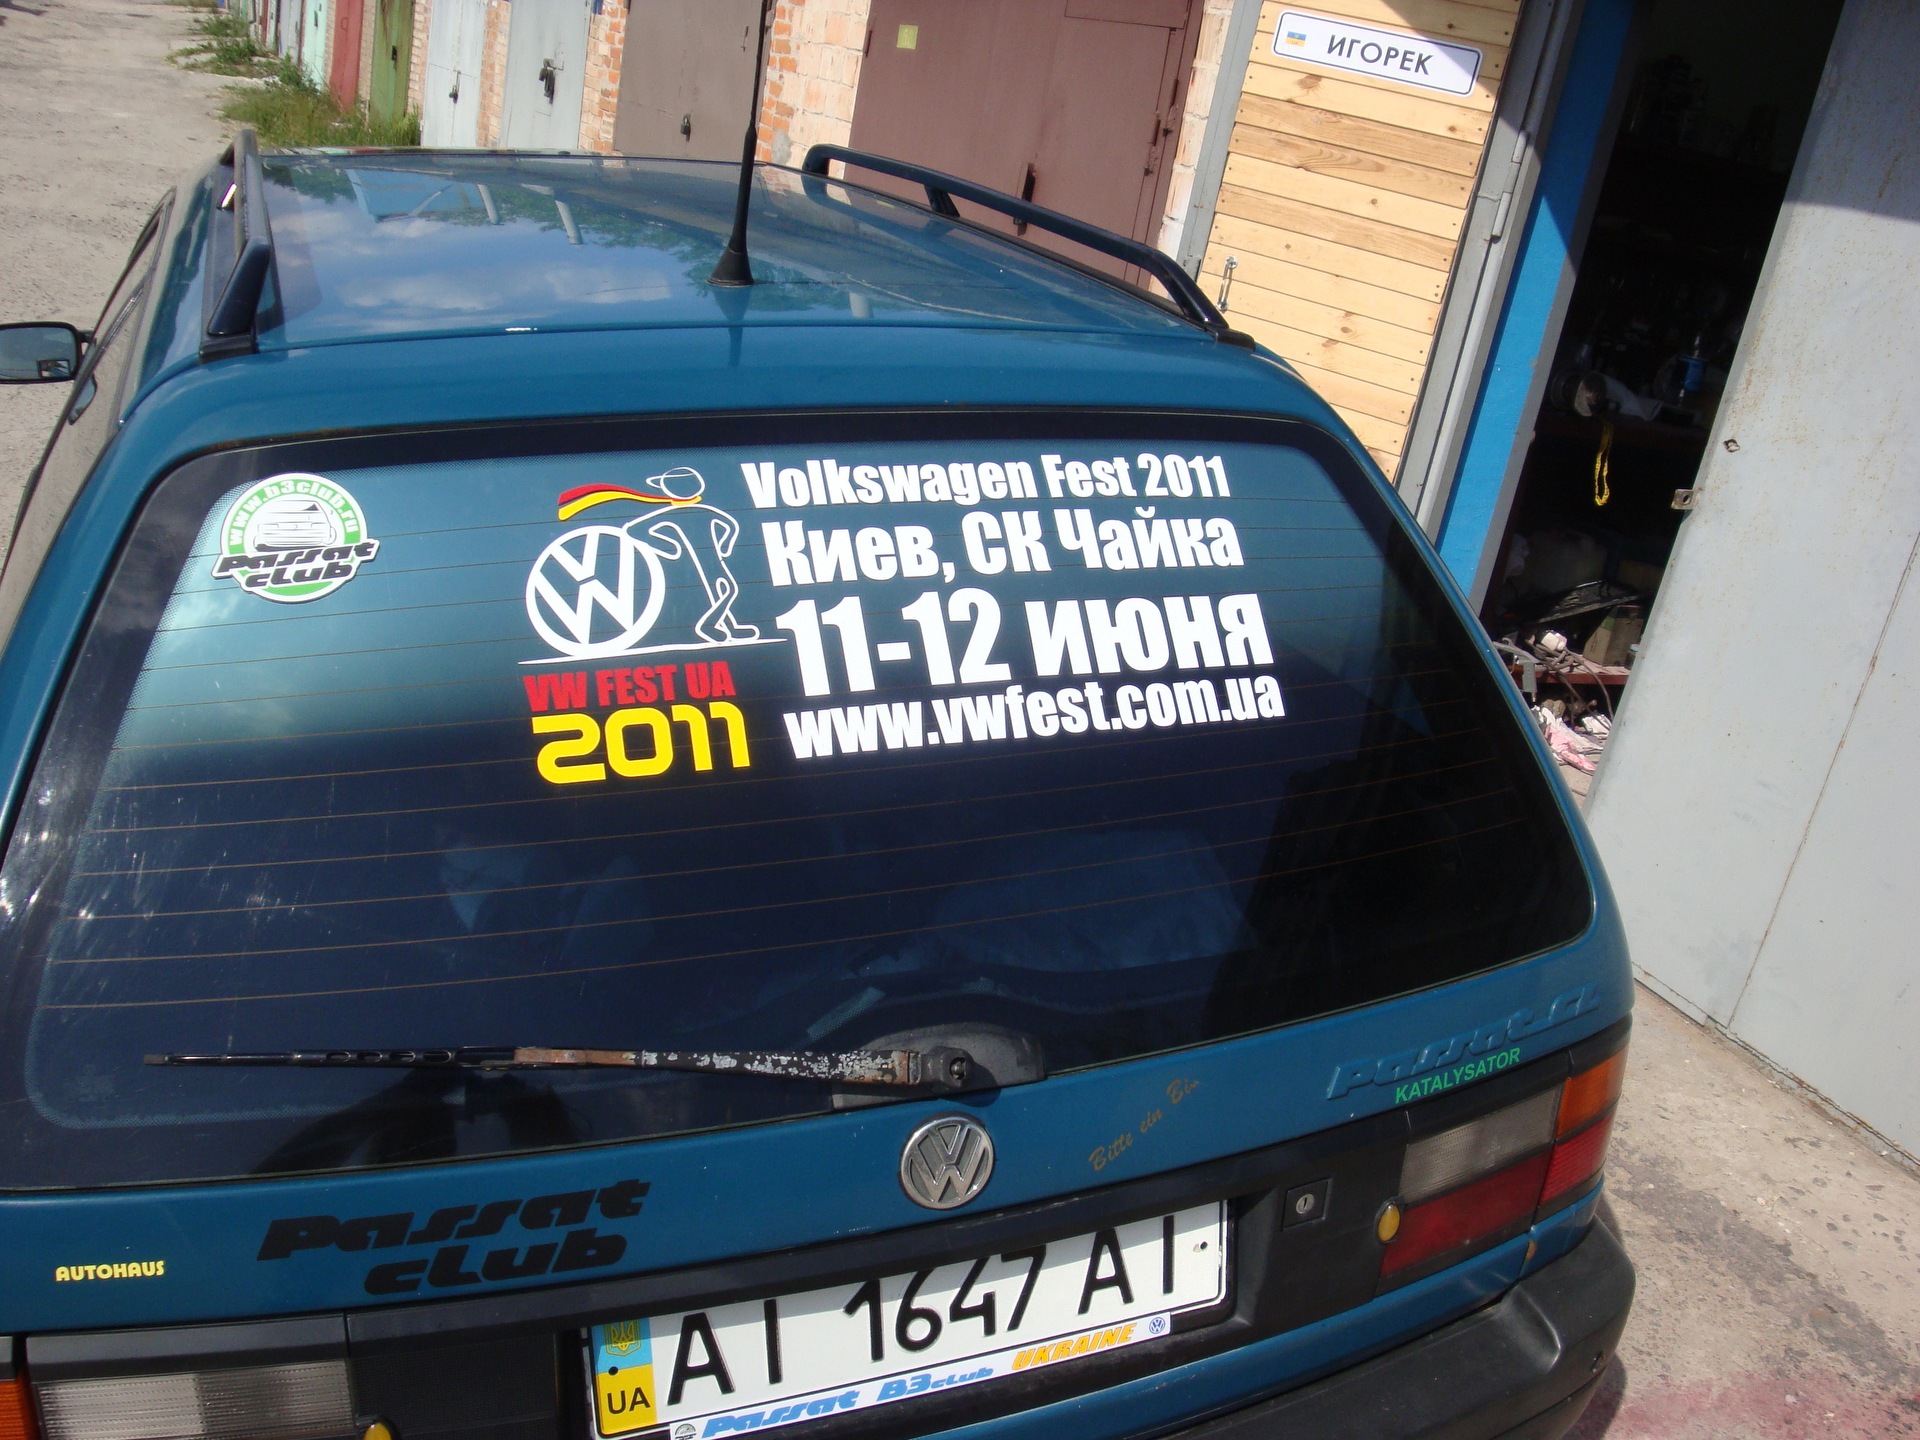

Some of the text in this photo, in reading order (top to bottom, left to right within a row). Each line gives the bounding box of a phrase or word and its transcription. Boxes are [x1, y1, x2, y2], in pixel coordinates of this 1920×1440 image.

[1326, 34, 1434, 76] ИГОРЕК
[740, 452, 1231, 509] Volkswagen Fest 2011
[229, 479, 360, 546] www.b3club.ru
[761, 505, 1245, 587] Киев, СК Чайка
[775, 586, 1012, 697] 11-12
[523, 660, 737, 712] VW FEST UA
[531, 701, 751, 785] 2011
[783, 674, 1286, 760] www.vwfest.com.ua
[1395, 1047, 1521, 1105] KATALYSATOR
[1089, 1132, 1134, 1172] Bitte
[1140, 1107, 1163, 1133] ein
[55, 1260, 165, 1282] AUTOHAUS
[666, 1214, 1175, 1407] AI 1647 AI
[1011, 1322, 1137, 1371] UKRAINE
[606, 1386, 651, 1415] UA
